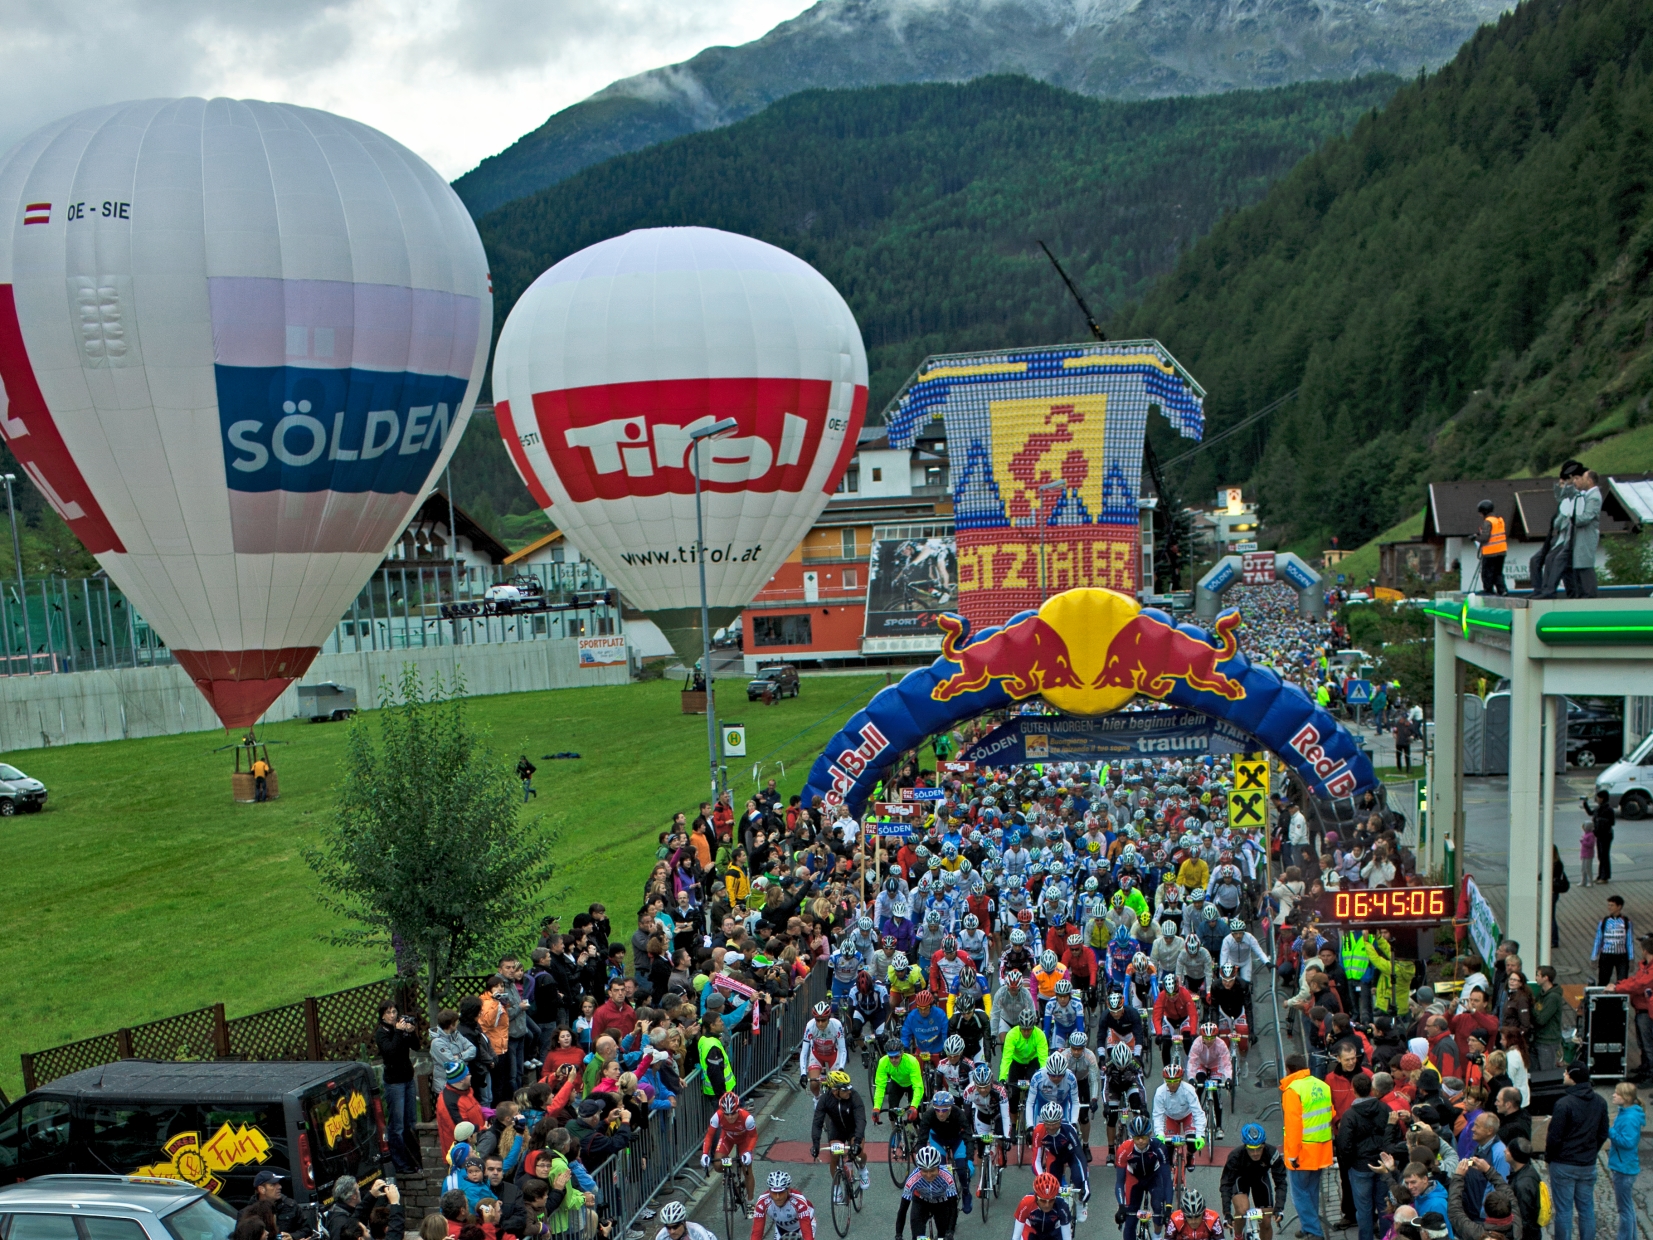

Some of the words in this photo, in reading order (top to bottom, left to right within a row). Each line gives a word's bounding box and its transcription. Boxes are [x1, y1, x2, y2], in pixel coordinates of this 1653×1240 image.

[228, 400, 461, 473] SÖLDEN
[564, 412, 808, 484] Tirol
[1243, 555, 1274, 571] ÖTZ
[1208, 567, 1232, 591] SÖLDEN
[1243, 571, 1274, 584] TAL
[1287, 564, 1311, 587] SÖLDEN
[580, 638, 624, 649] SPORTPLATZ
[1020, 720, 1051, 734] GUTEN
[1101, 717, 1126, 731] hier
[1129, 713, 1177, 734] beginnt
[1179, 713, 1207, 727] dein
[837, 722, 890, 778] Bull
[970, 734, 1018, 762] SÖLDEN
[1137, 735, 1208, 752] traum
[1289, 723, 1348, 780] Red
[944, 762, 970, 772] Tirol
[914, 788, 944, 799] SÖLDEN
[884, 804, 914, 816] Tirol
[877, 823, 912, 835] SÖLDEN
[1335, 890, 1444, 917] 06:45:06
[169, 1135, 196, 1154] BIKES
[208, 1131, 259, 1168] Fun
